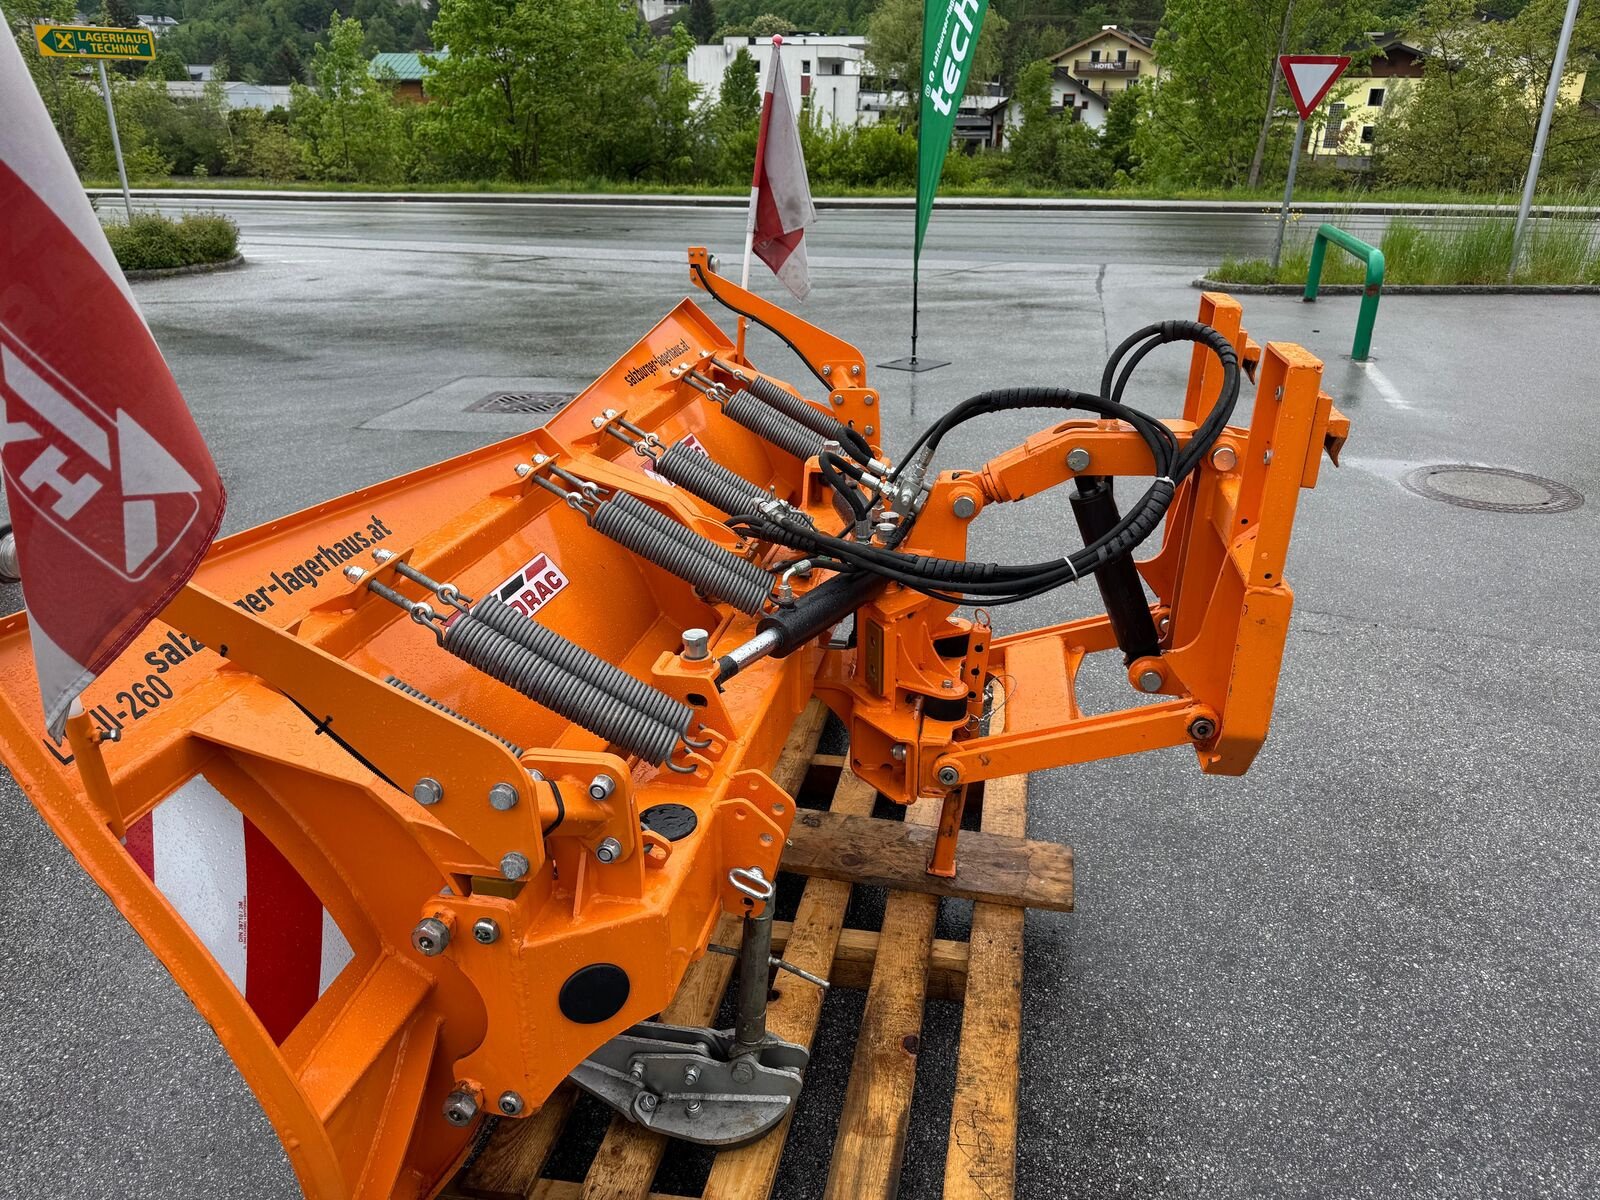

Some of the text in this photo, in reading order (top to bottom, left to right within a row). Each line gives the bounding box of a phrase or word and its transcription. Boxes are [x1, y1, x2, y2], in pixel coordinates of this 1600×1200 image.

[77, 32, 148, 44] LAGERHAUS
[90, 43, 141, 54] TECHNIK
[624, 338, 691, 387] salzburger-lagerhaus.at
